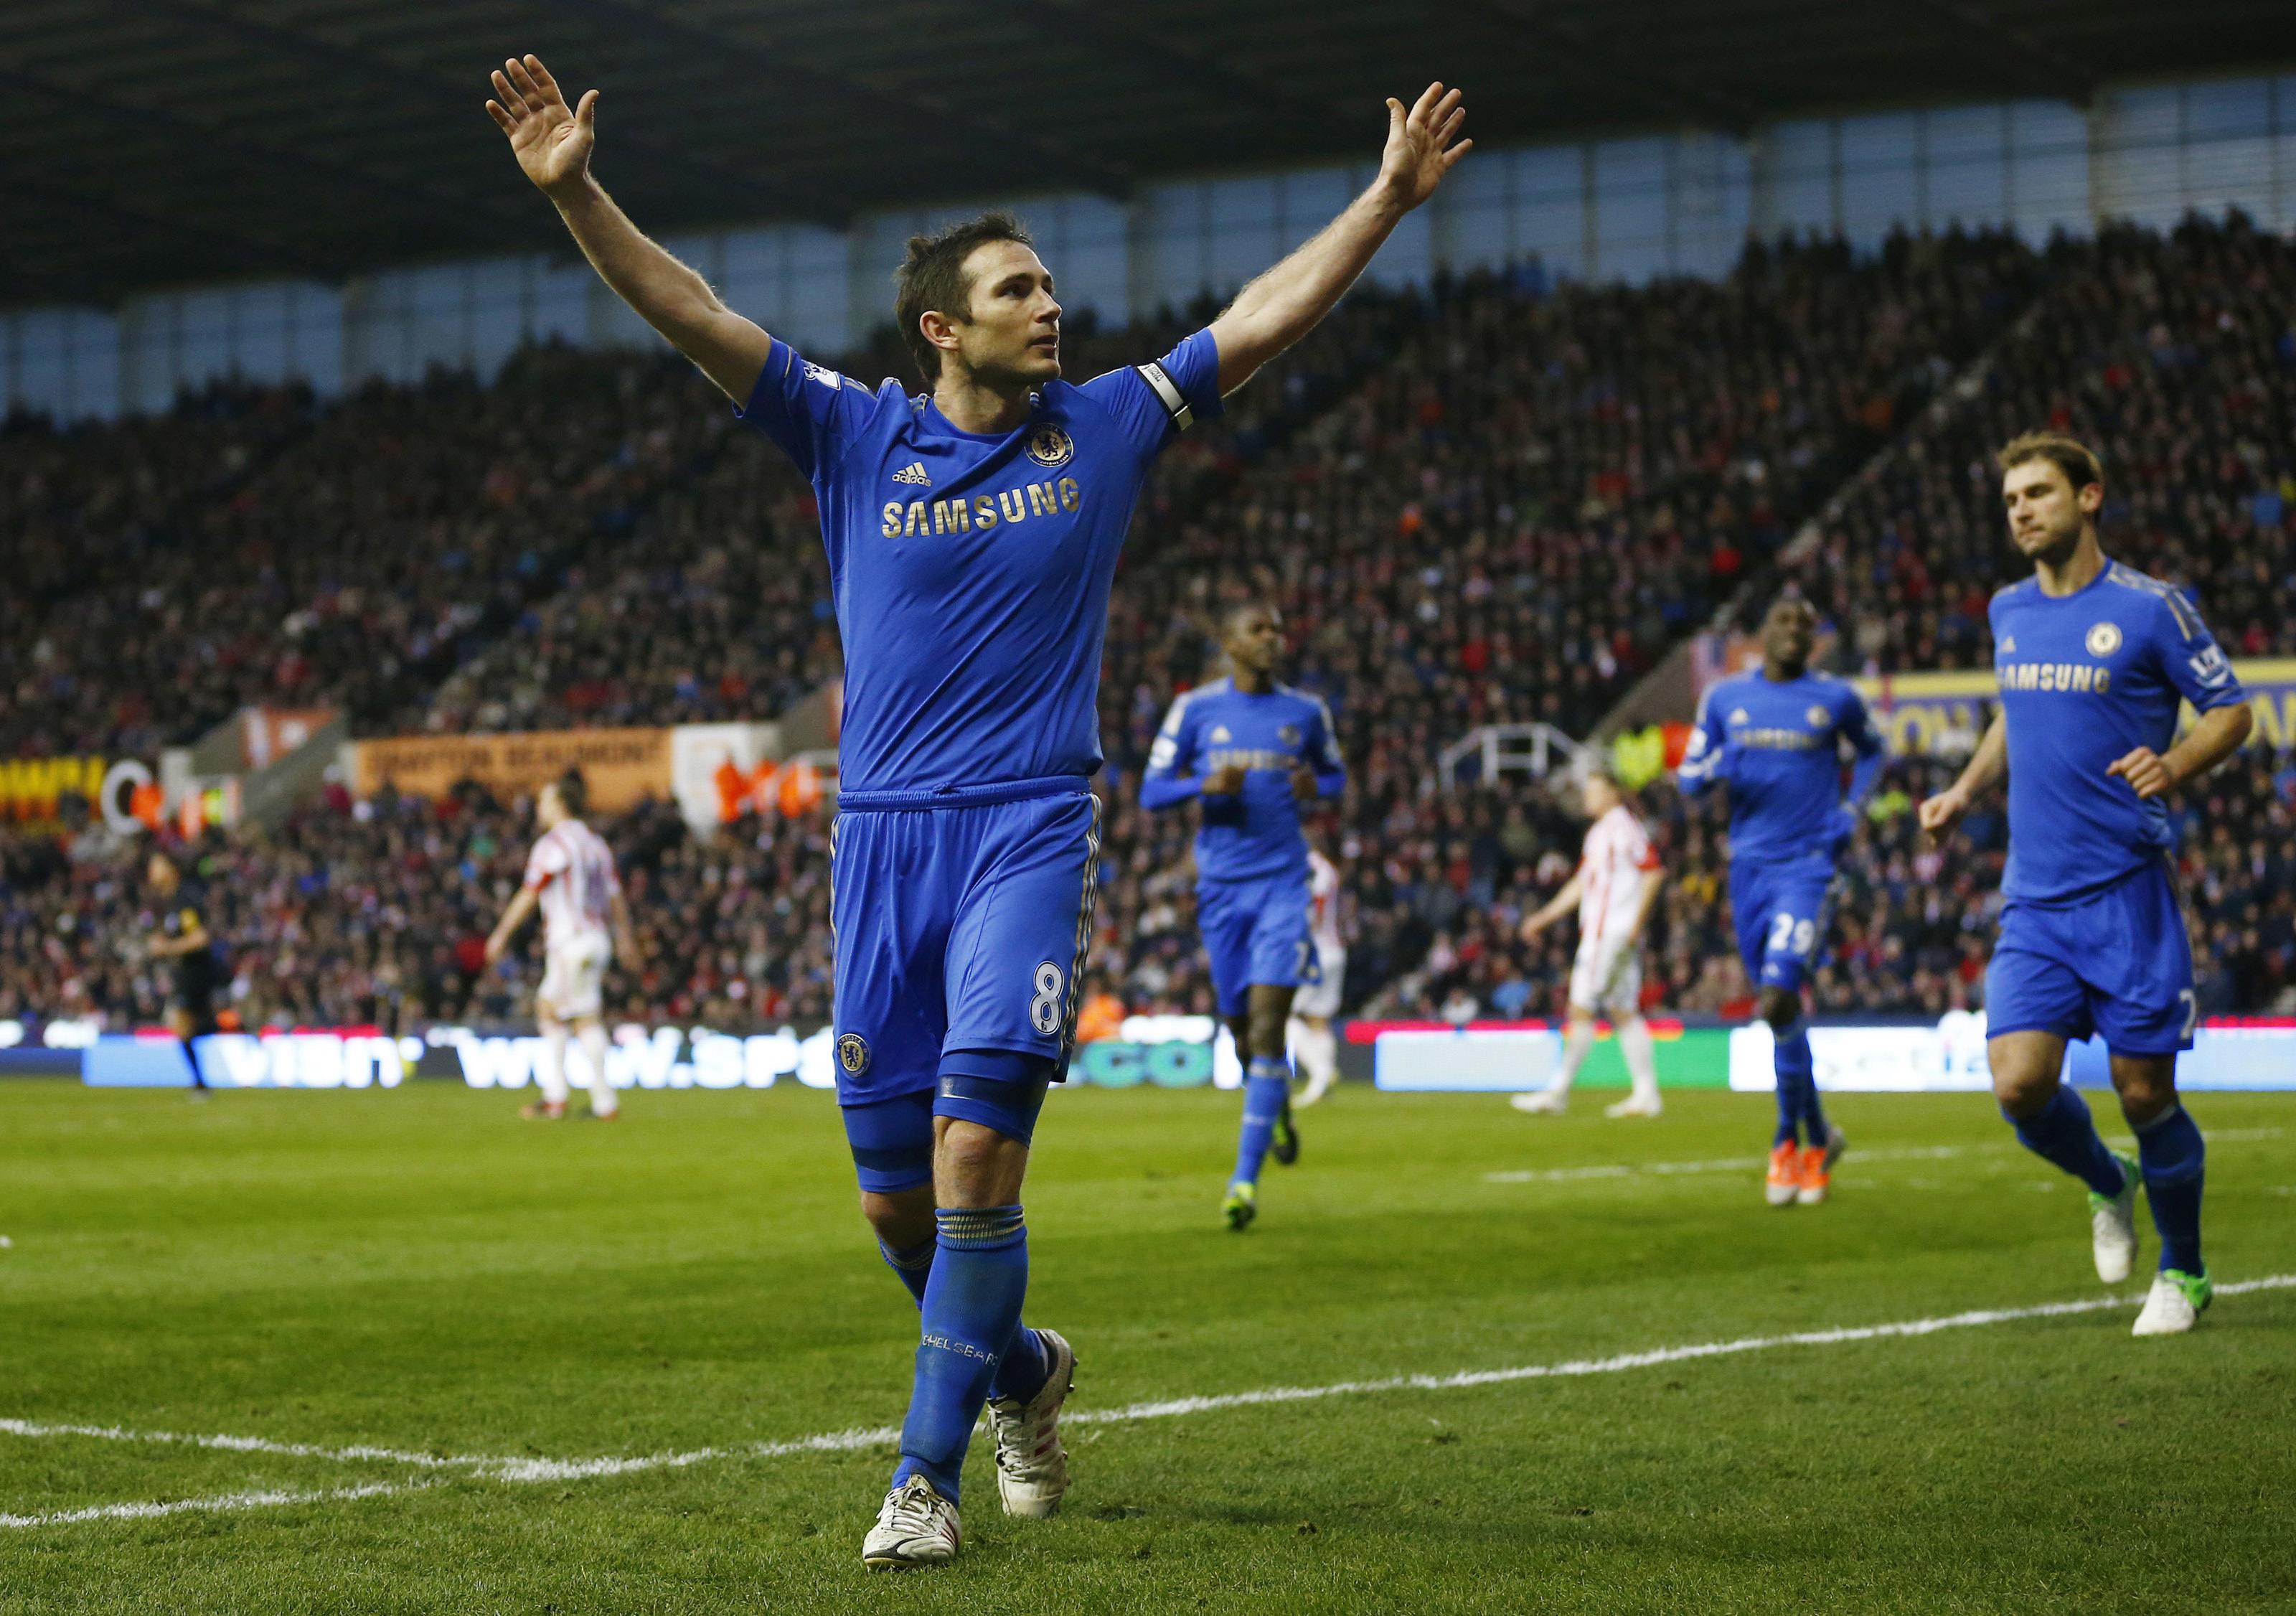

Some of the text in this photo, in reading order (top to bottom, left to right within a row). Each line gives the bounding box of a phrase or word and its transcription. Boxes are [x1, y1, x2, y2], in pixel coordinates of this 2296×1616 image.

[891, 473, 932, 488] adidas
[881, 476, 1080, 539] SAMSUNG
[1768, 911, 1815, 956] 29
[1029, 960, 1065, 1035] 8
[922, 1334, 984, 1362] CHELSEA
